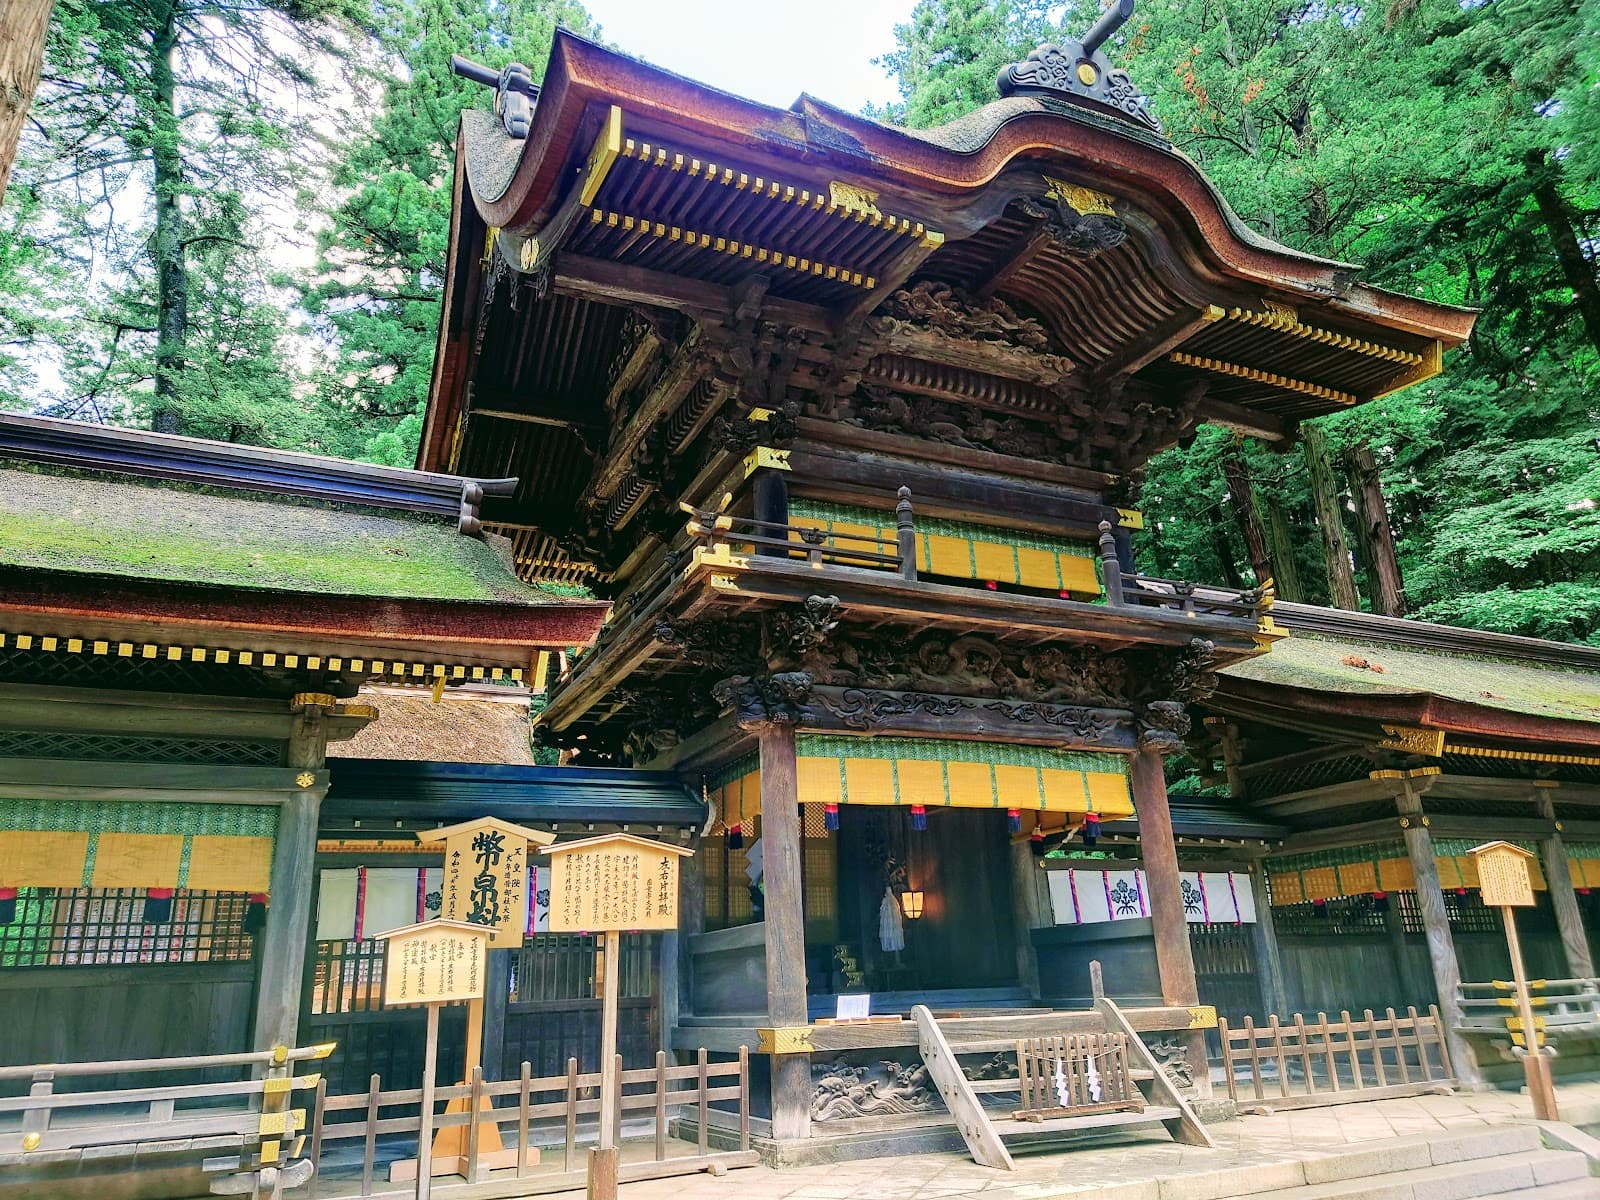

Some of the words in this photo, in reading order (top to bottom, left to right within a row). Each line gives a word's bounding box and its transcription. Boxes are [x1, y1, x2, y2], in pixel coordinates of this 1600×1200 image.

[466, 830, 506, 941] 幣帛料
[512, 848, 522, 904] 天皇陛下
[657, 856, 671, 916] 左右片拝殿
